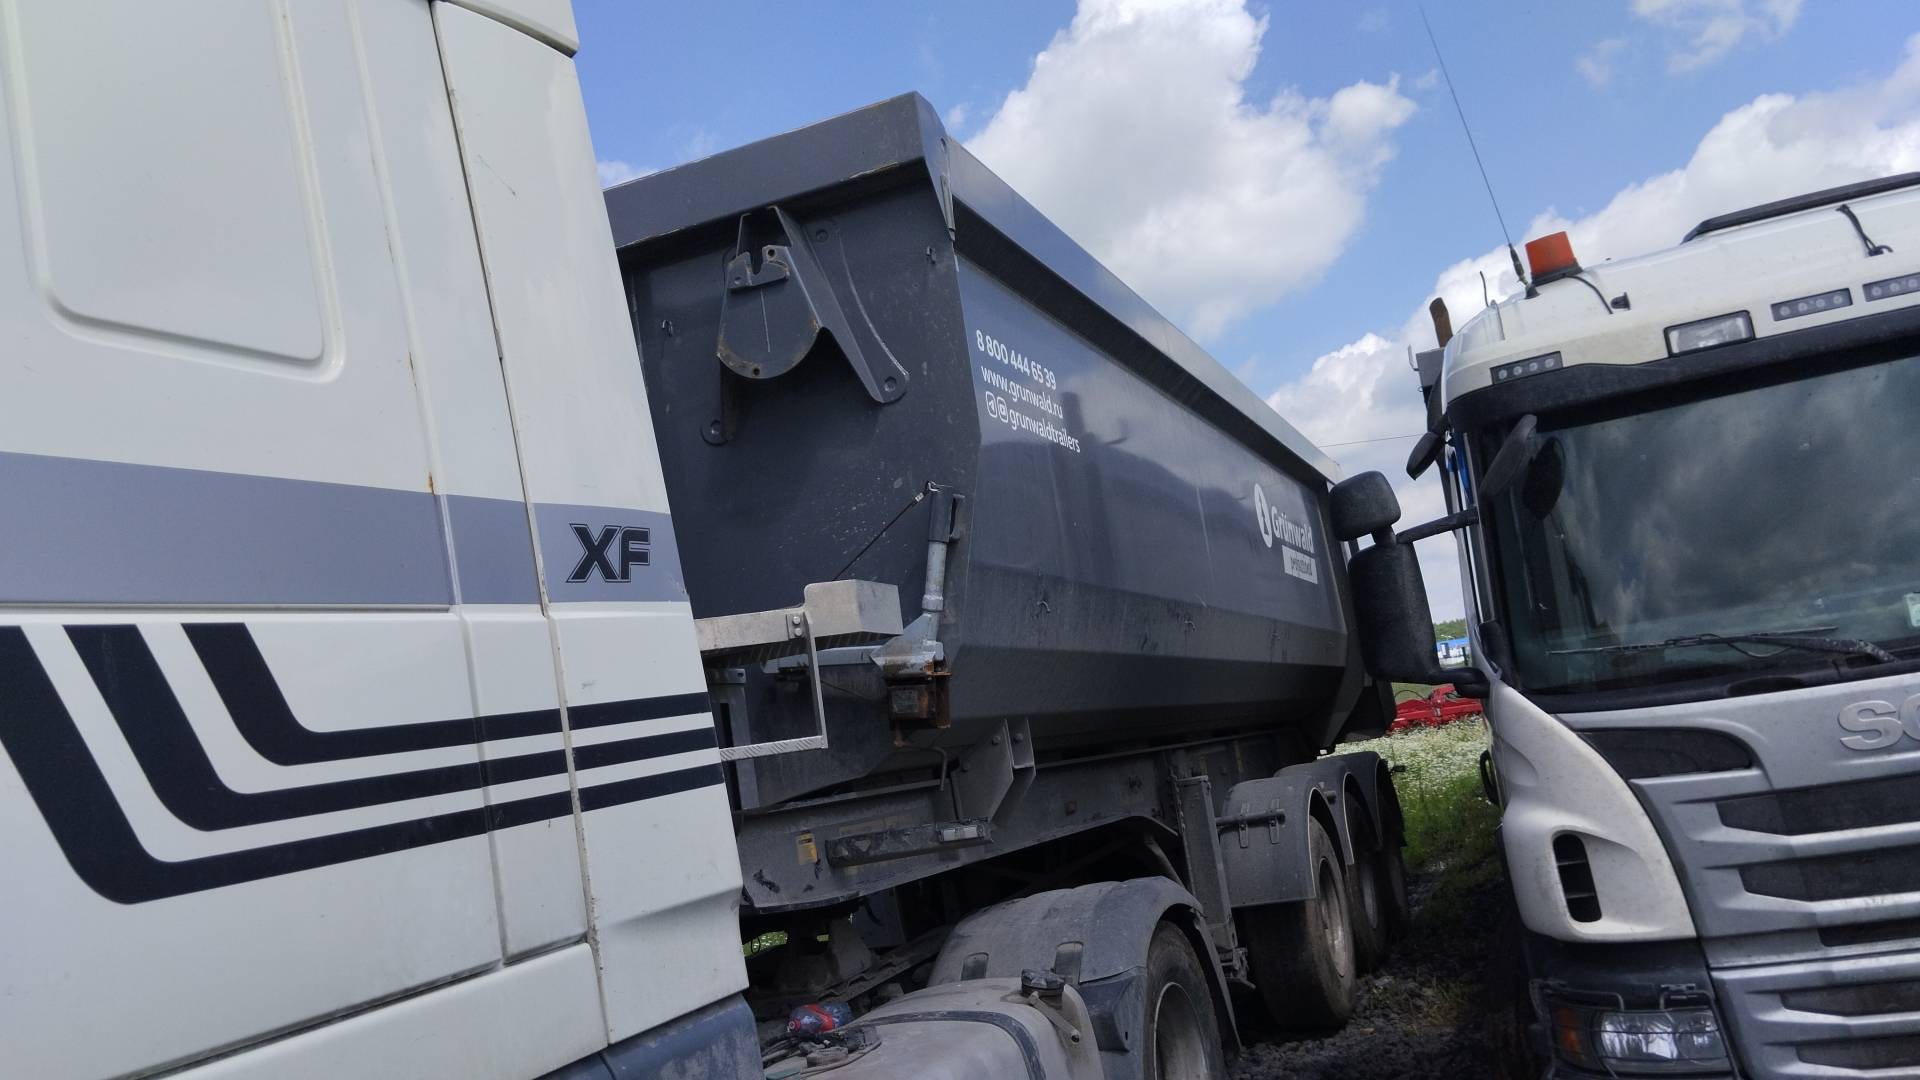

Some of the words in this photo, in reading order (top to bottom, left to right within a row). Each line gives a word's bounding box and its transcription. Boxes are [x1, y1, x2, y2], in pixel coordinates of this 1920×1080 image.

[976, 329, 984, 351] 8
[985, 335, 1008, 364] 800
[1010, 350, 1030, 376] 444
[1031, 361, 1044, 383] 65
[1044, 368, 1056, 390] 39
[981, 365, 1063, 419] www.grunwald.ru
[1009, 409, 1081, 453] grunwaldtrailers
[566, 522, 651, 583] XF
[1837, 692, 1920, 752] S
